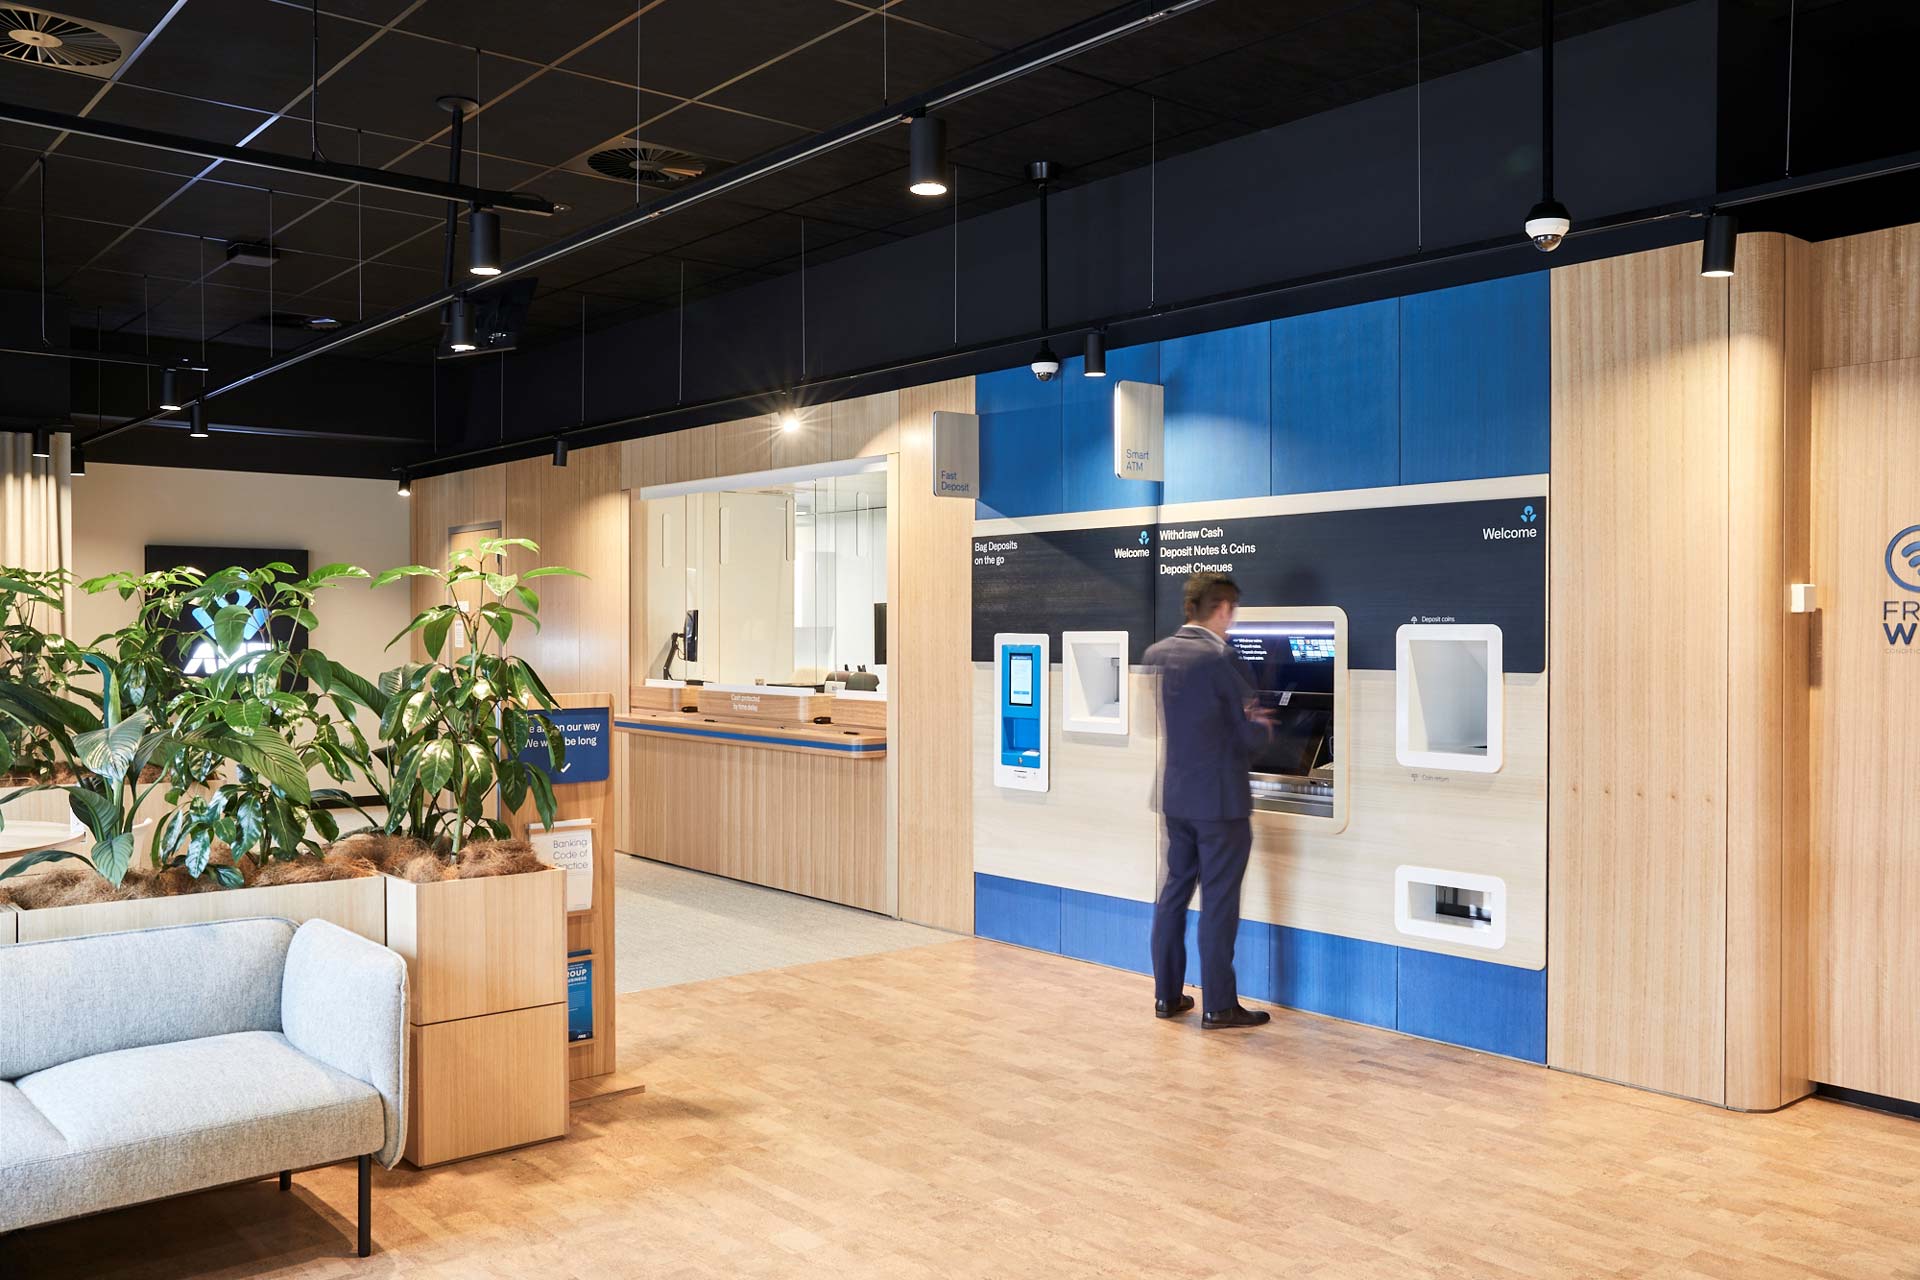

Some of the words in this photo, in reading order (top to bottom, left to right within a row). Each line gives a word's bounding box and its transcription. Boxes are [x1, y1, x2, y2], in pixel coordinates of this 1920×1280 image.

[1126, 449, 1149, 460] Smart
[1126, 461, 1144, 471] ATM
[941, 470, 957, 480] Fast
[941, 481, 969, 492] Deposit
[1160, 529, 1200, 541] Withdraw
[1200, 527, 1224, 538] Cash
[1483, 527, 1537, 540] Welcome
[974, 542, 988, 552] Bag
[988, 540, 1018, 552] Deposits
[1160, 546, 1193, 559] Deposit
[1193, 545, 1220, 556] Notes
[1220, 544, 1228, 555] &
[1229, 543, 1256, 554] Coins
[1114, 548, 1150, 559] Welcome
[974, 557, 984, 565] on
[984, 556, 996, 564] the
[996, 556, 1005, 566] go
[1160, 563, 1193, 576] Deposit
[1193, 562, 1233, 573] Cheques
[1882, 622, 1918, 646] W
[566, 724, 582, 732] our
[583, 723, 600, 732] way
[564, 737, 577, 746] be
[578, 736, 597, 746] long
[553, 839, 588, 848] Banking
[553, 851, 577, 860] Code
[579, 850, 588, 858] of
